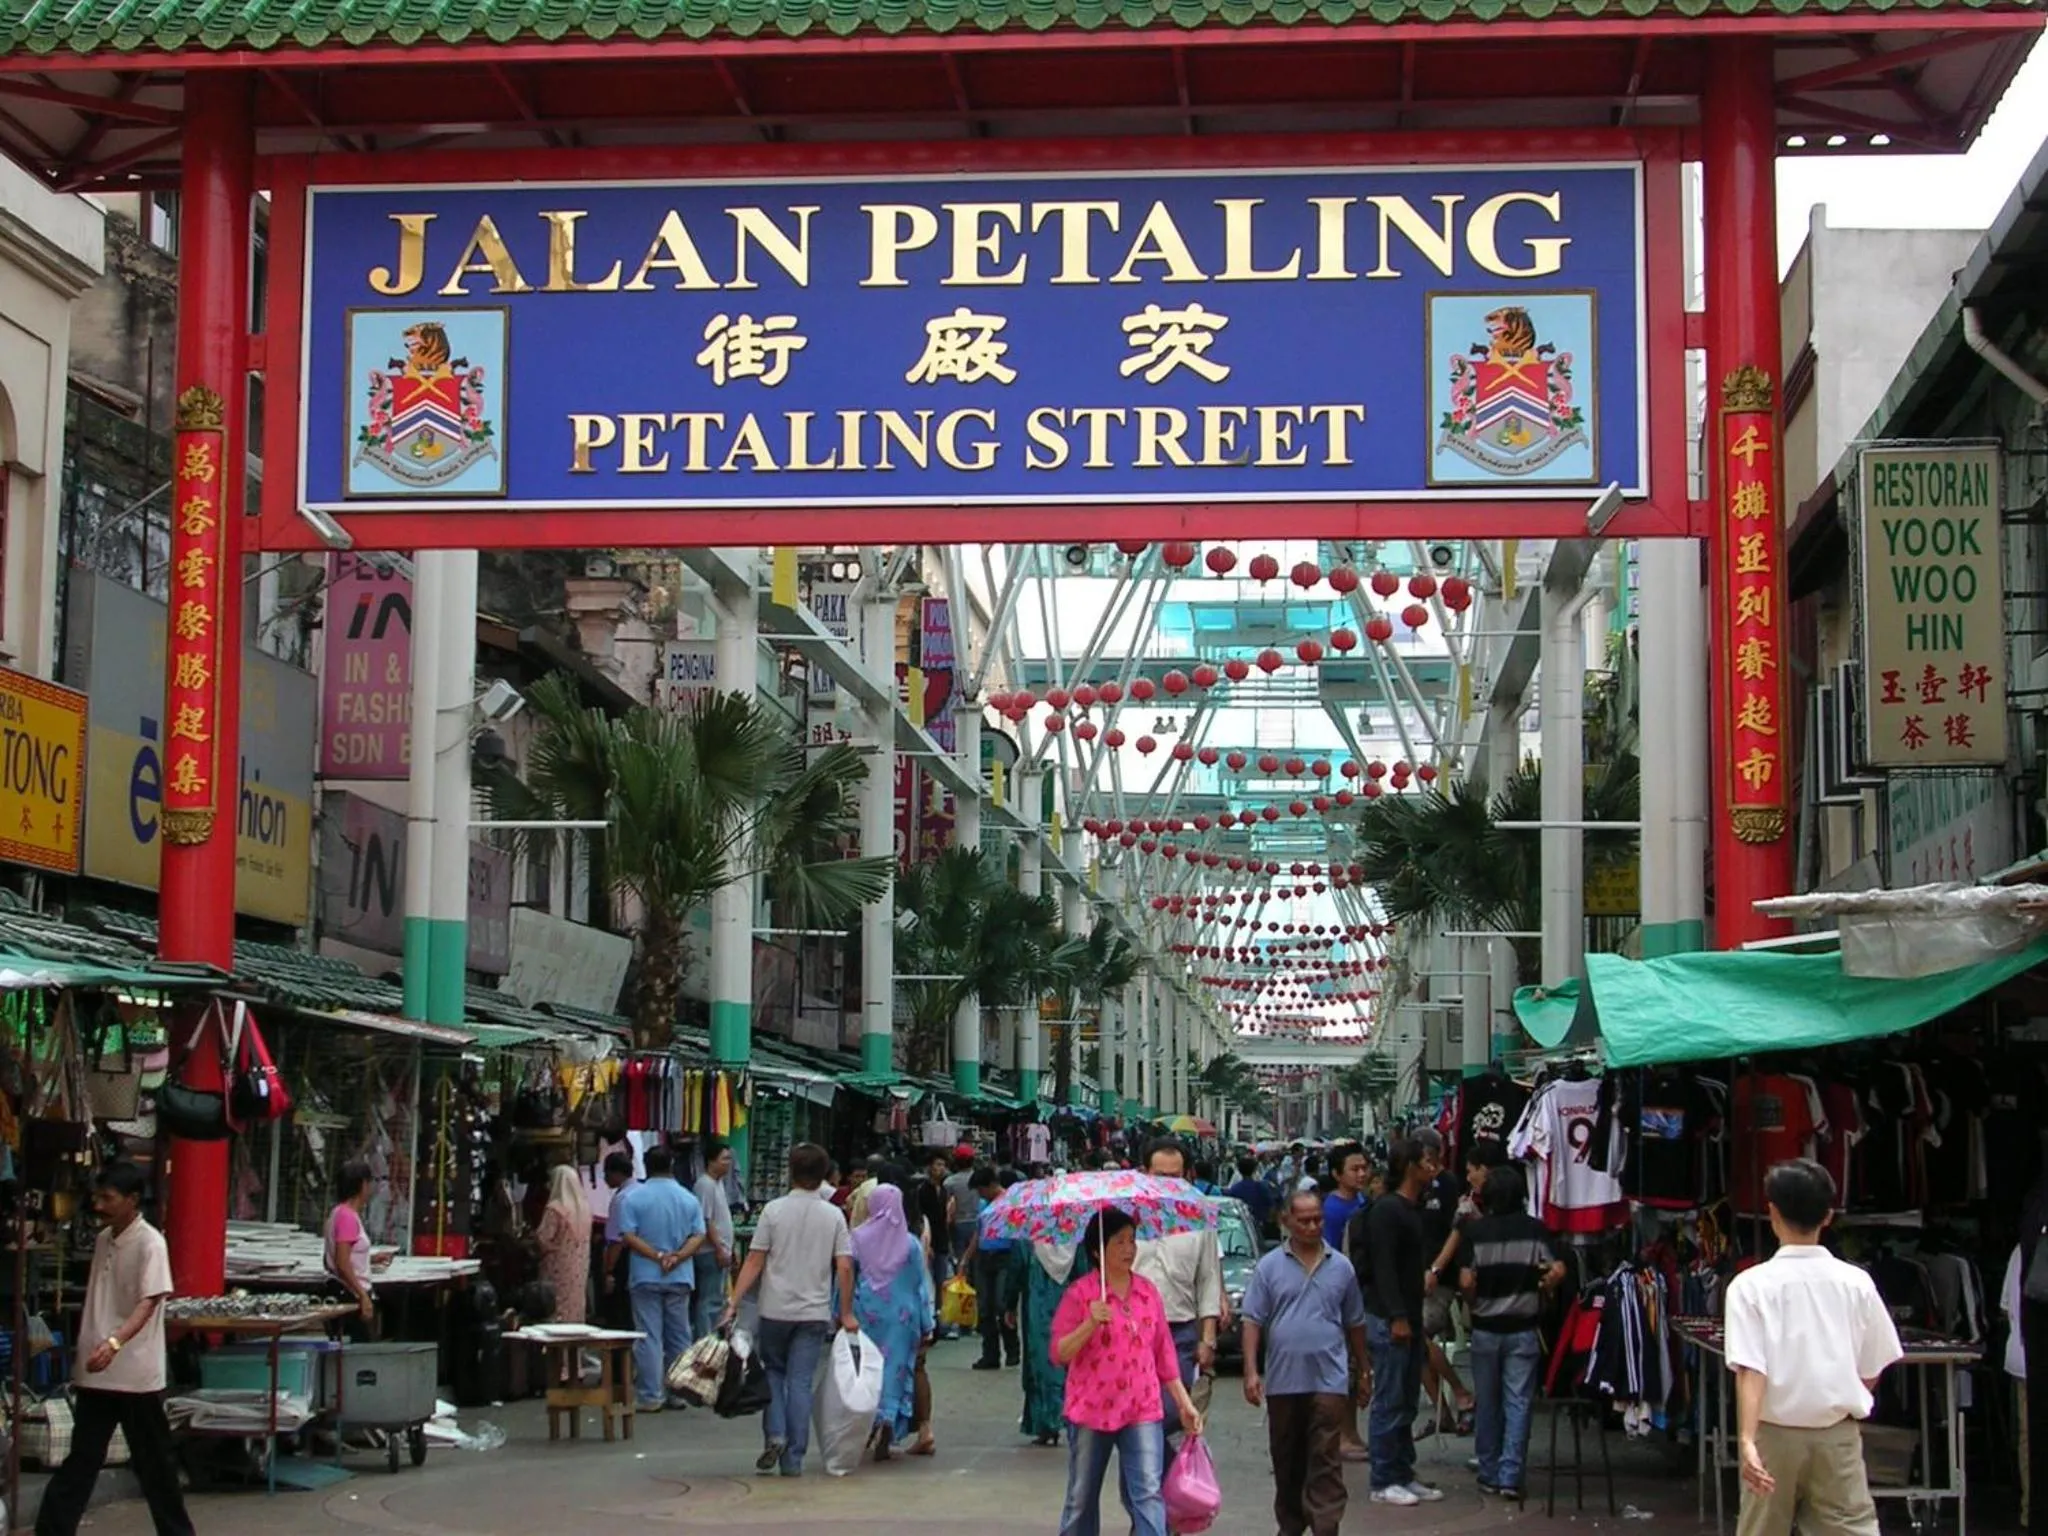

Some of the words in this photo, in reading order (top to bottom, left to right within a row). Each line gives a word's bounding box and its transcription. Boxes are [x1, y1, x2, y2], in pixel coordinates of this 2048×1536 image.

[368, 204, 821, 297] JALAN
[858, 190, 1572, 288] PETALING
[567, 408, 1001, 474] PETALING
[1025, 404, 1365, 470] STREET
[1873, 461, 1989, 508] RESTORAN
[1881, 517, 1982, 558] YOOK
[1891, 564, 1978, 604] WOO
[814, 594, 851, 623] PAKA
[1907, 613, 1963, 651] HIN
[384, 652, 402, 684] &
[3, 728, 69, 805] TONG
[332, 733, 384, 765] SDN
[1567, 1116, 1593, 1164] 9
